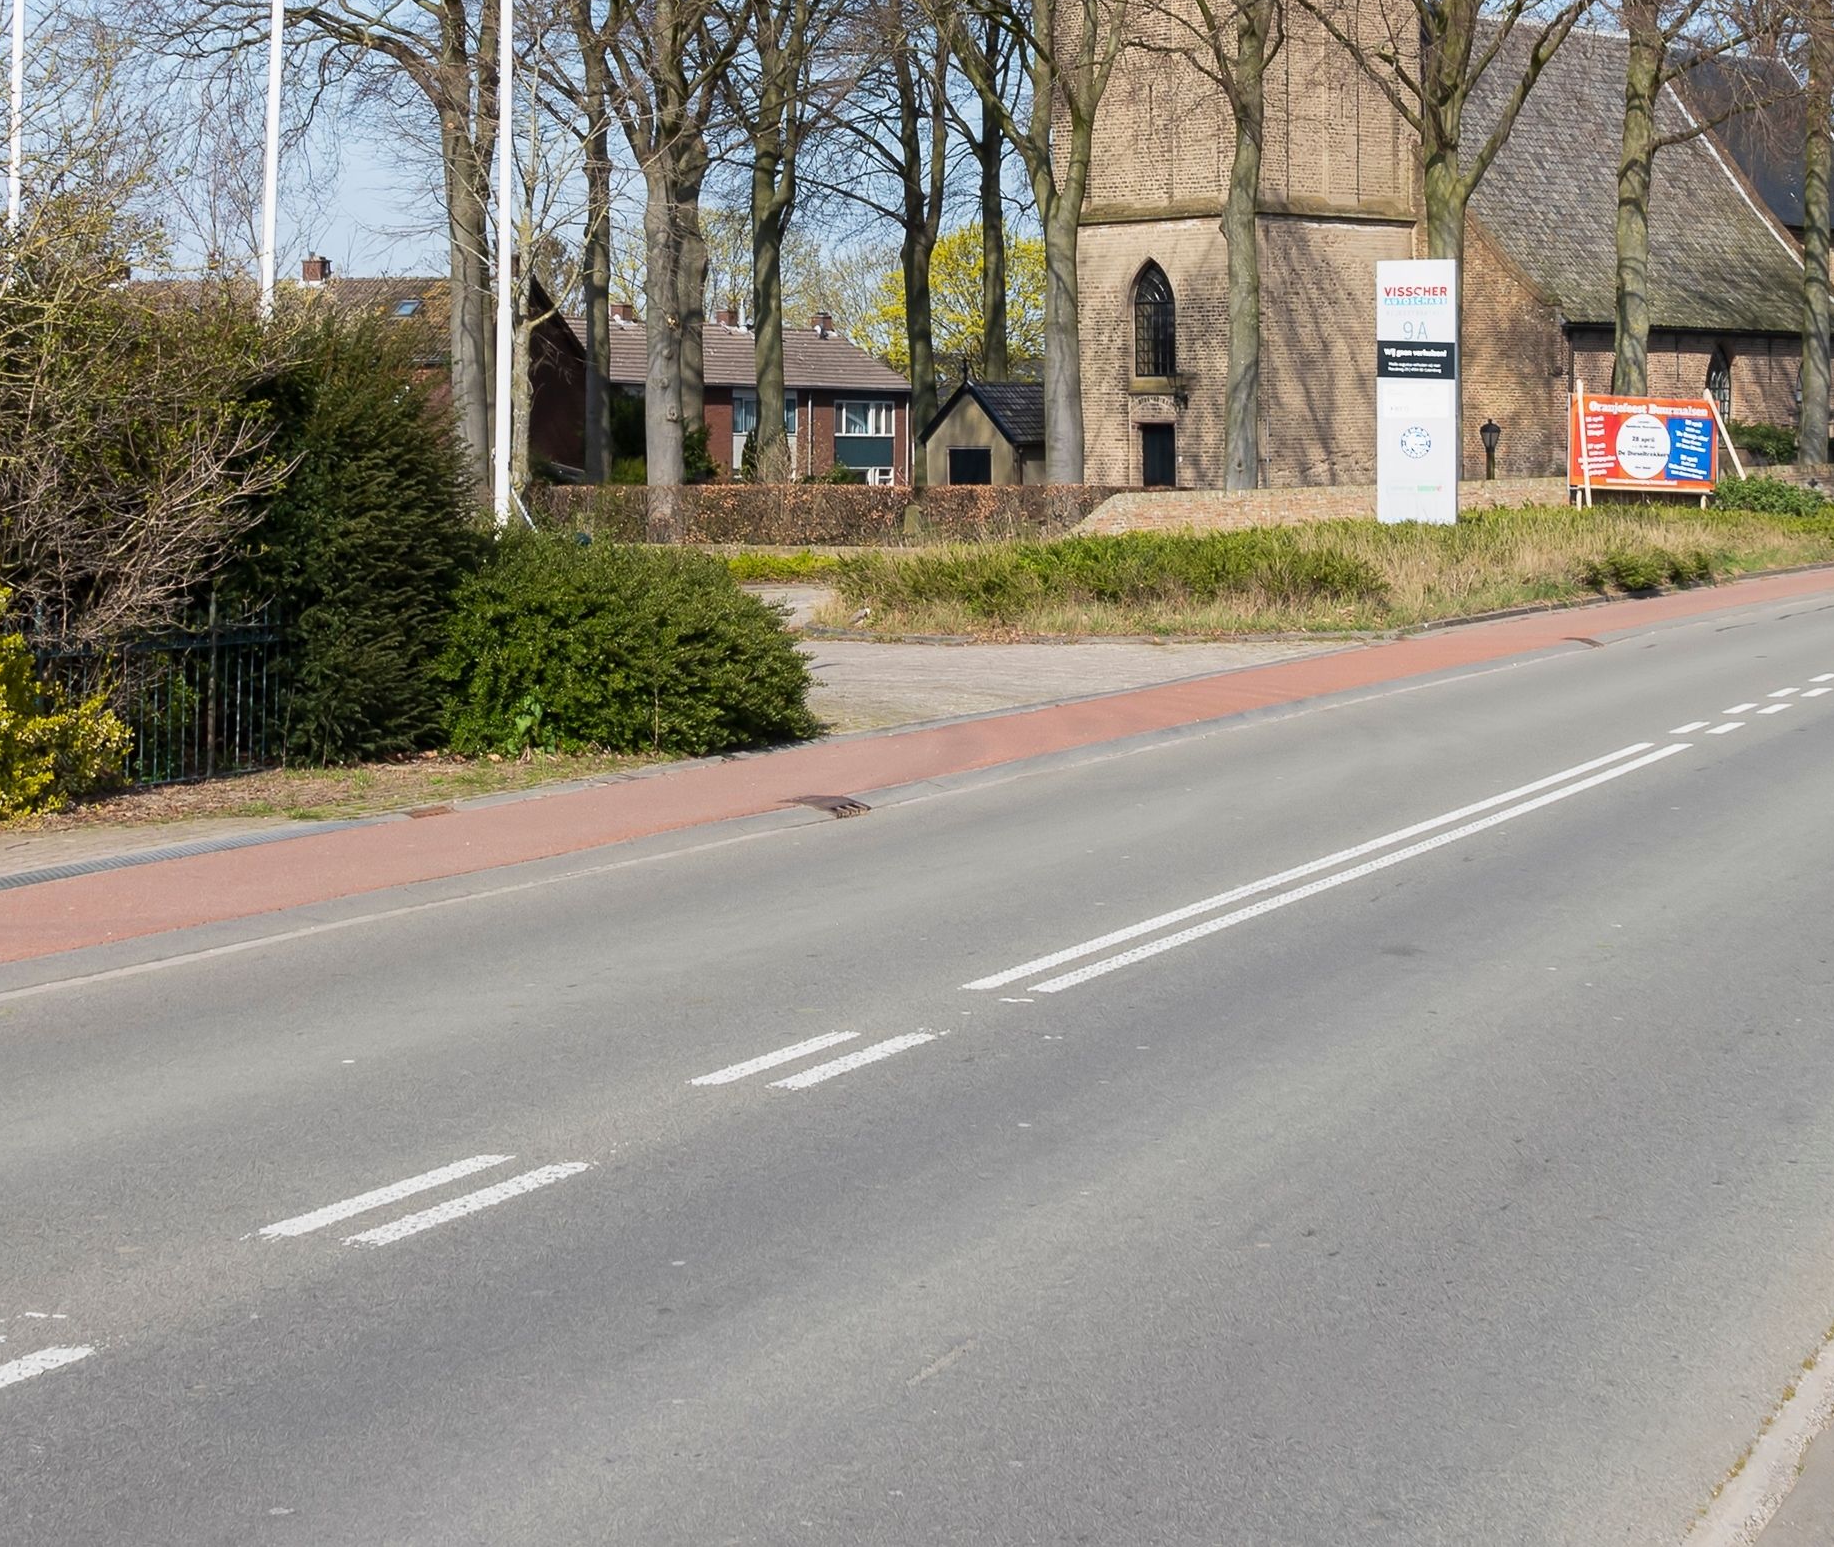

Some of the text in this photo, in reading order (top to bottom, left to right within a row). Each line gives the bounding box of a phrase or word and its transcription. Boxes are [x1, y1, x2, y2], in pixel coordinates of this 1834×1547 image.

[1384, 286, 1447, 297] VISSCHER
[1384, 348, 1396, 357] Wij
[1588, 400, 1708, 416] Oranjefeest Buurmalsen
